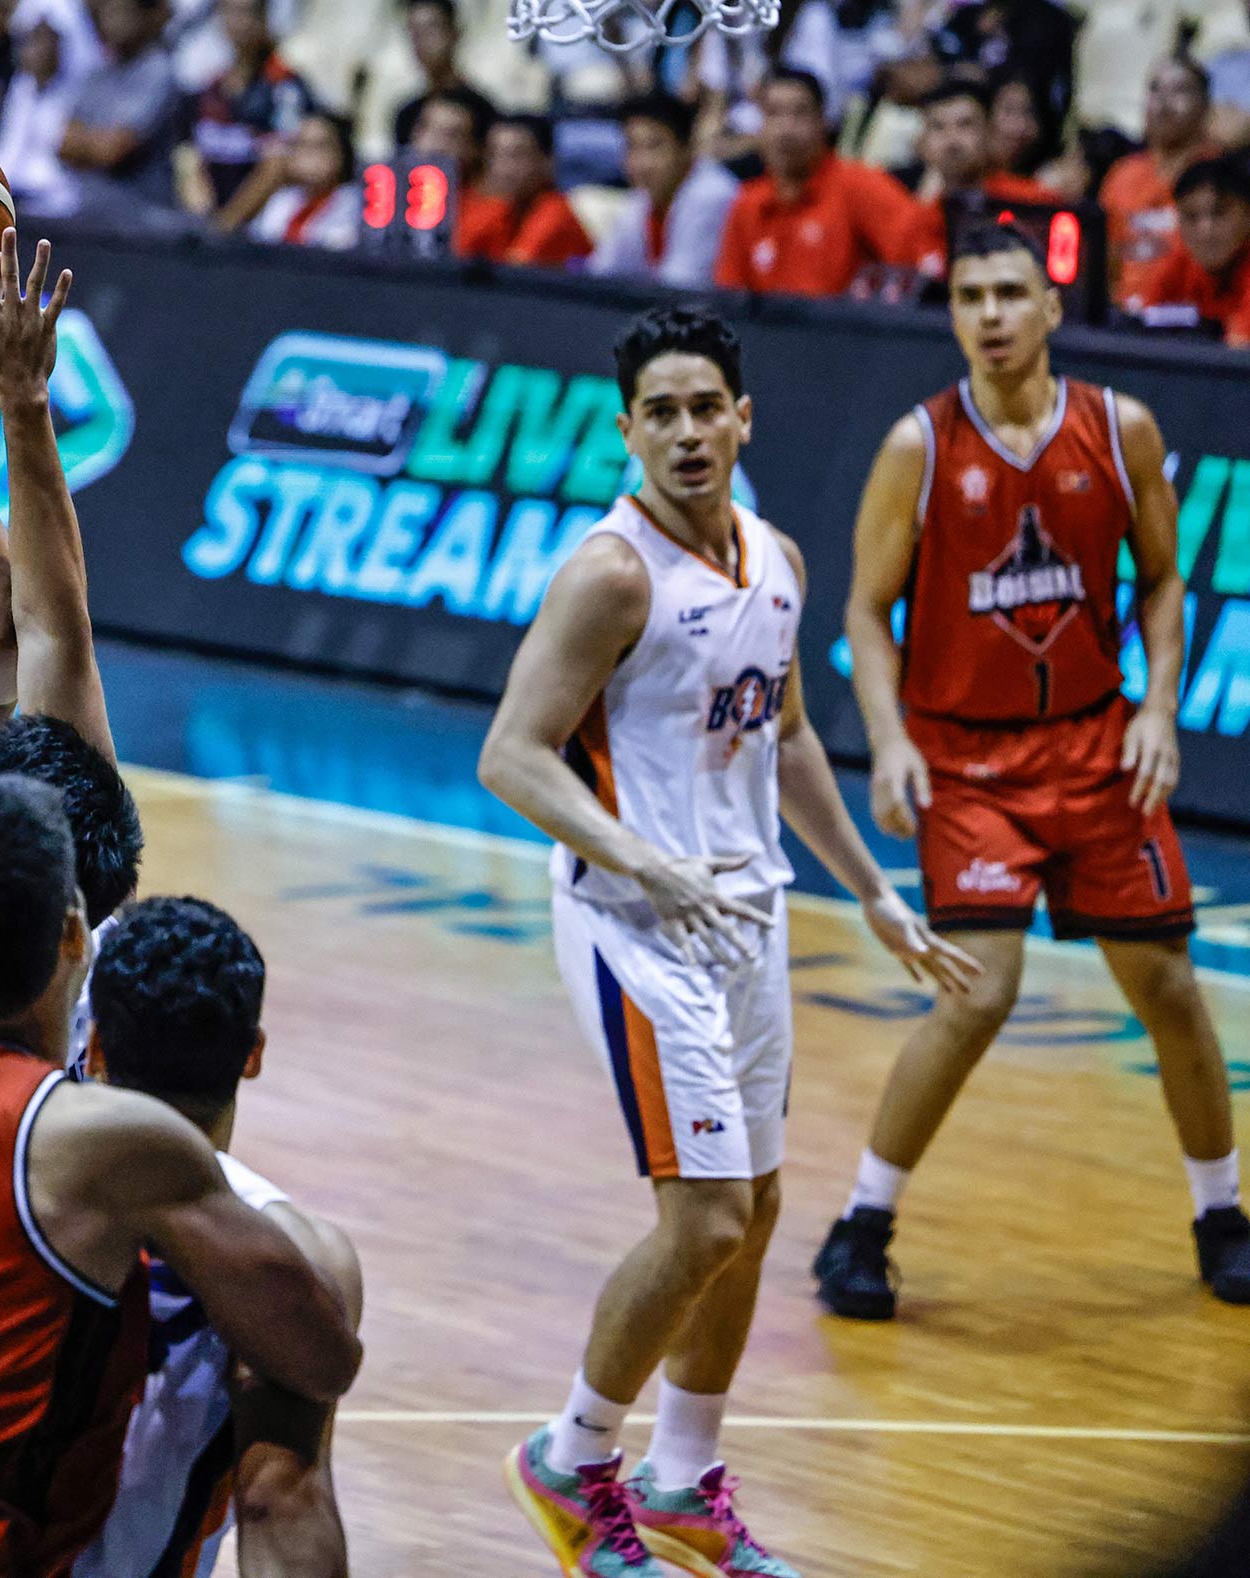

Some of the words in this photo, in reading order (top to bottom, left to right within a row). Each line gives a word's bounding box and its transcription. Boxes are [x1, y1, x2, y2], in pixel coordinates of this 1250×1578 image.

[362, 163, 449, 230] 33
[405, 357, 630, 506] LIVE
[1032, 660, 1053, 716] 1
[1138, 836, 1172, 902] 1
